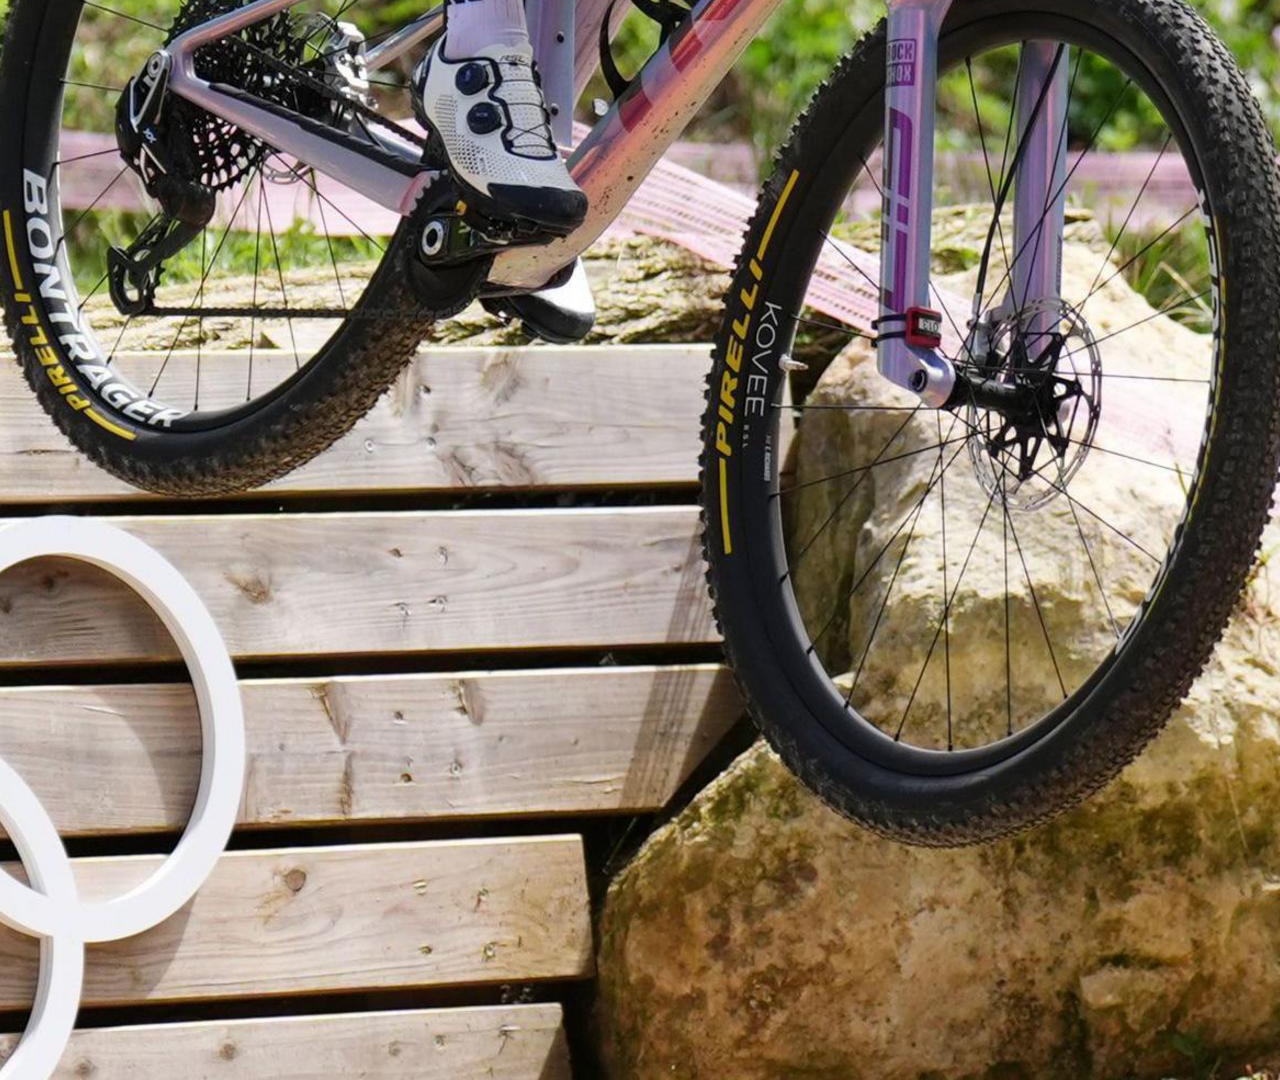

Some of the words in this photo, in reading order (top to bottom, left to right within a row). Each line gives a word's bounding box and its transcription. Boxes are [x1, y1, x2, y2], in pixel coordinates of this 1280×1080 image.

[14, 292, 91, 412] PIRELLI
[23, 168, 193, 428] BONTRAGER
[716, 258, 763, 456] PIRELLI
[744, 301, 783, 417] KOVEE
